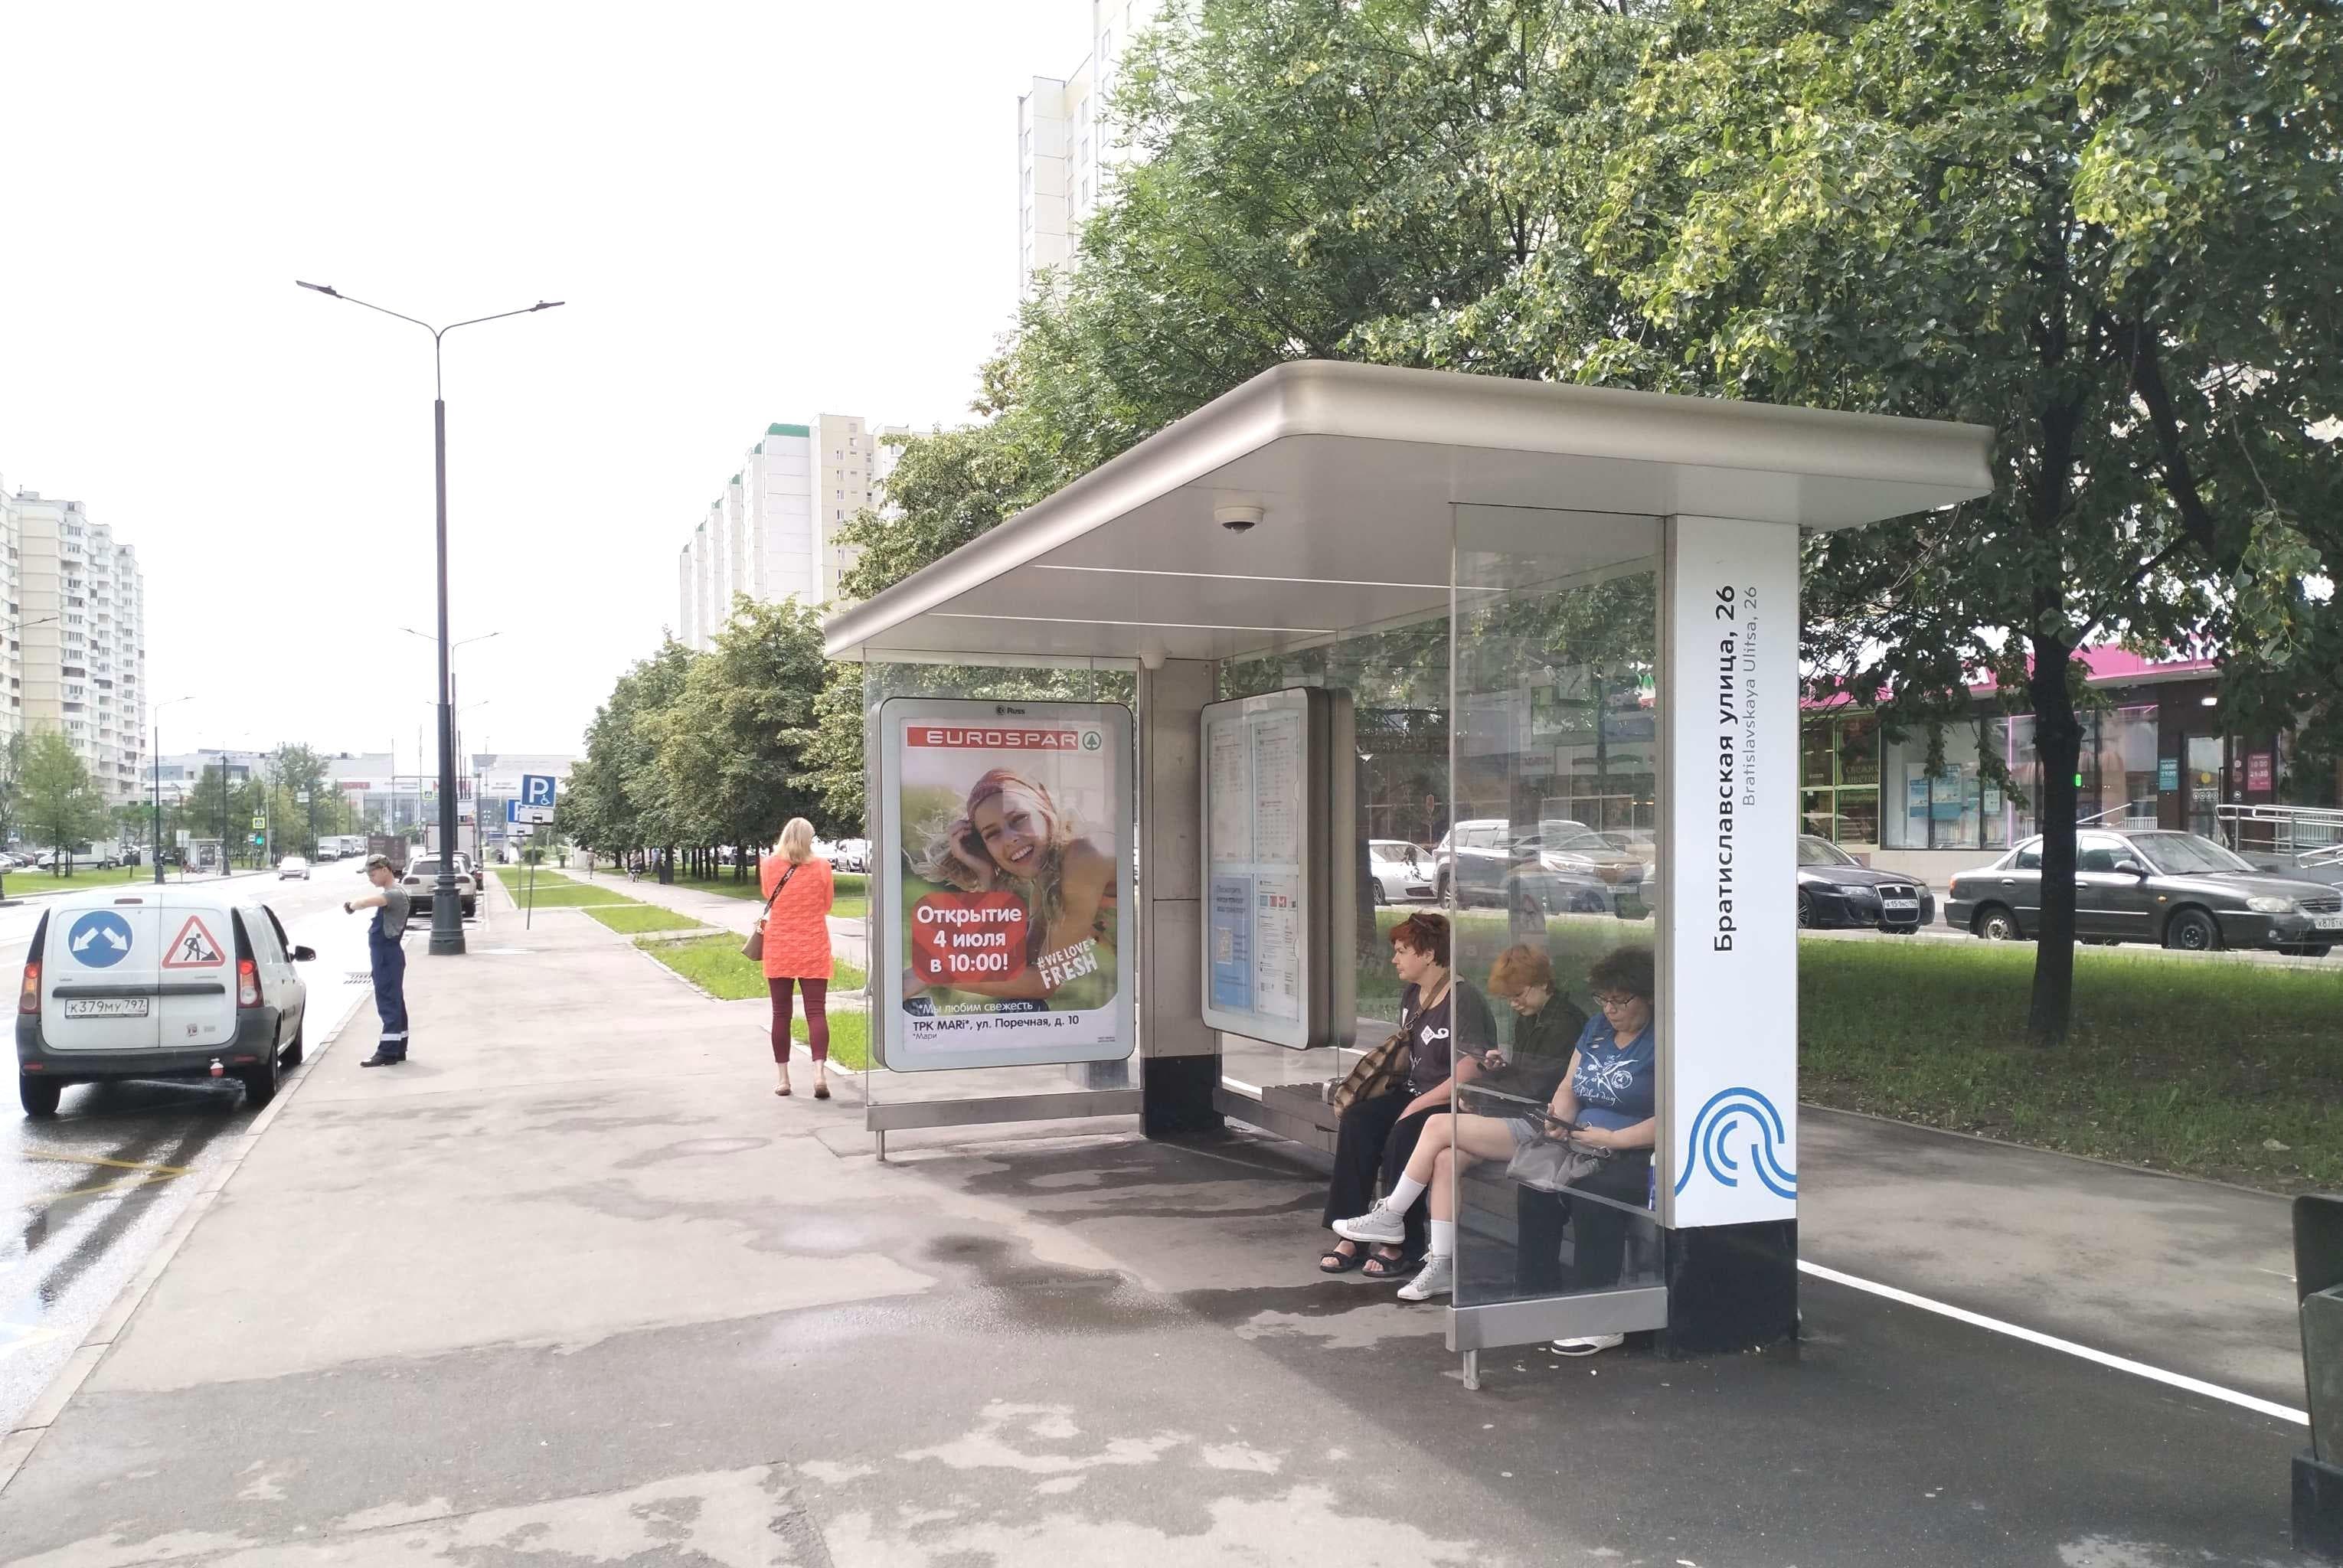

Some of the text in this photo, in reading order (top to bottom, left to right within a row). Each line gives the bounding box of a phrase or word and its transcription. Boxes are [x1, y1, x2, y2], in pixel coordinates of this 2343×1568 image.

[1742, 586, 1759, 805] Bratislavskaya Ulitsa, 26
[926, 730, 1077, 747] EUROSPAR
[1714, 584, 1738, 952] Братиславская улица, 26
[529, 777, 549, 803] P
[917, 906, 1022, 927] Открытие
[933, 930, 1006, 948] 4 июля
[930, 953, 1008, 972] в 10:00!
[1036, 951, 1064, 971] #WE
[1040, 952, 1098, 989] FRESH
[945, 1002, 982, 1013] любим
[984, 1001, 1034, 1012] свежесть
[913, 1021, 934, 1031] ТРК
[976, 1021, 992, 1032] ул.
[995, 1017, 1052, 1029] Поречная,
[1054, 1018, 1065, 1028] д.
[1068, 1015, 1080, 1025] 10
